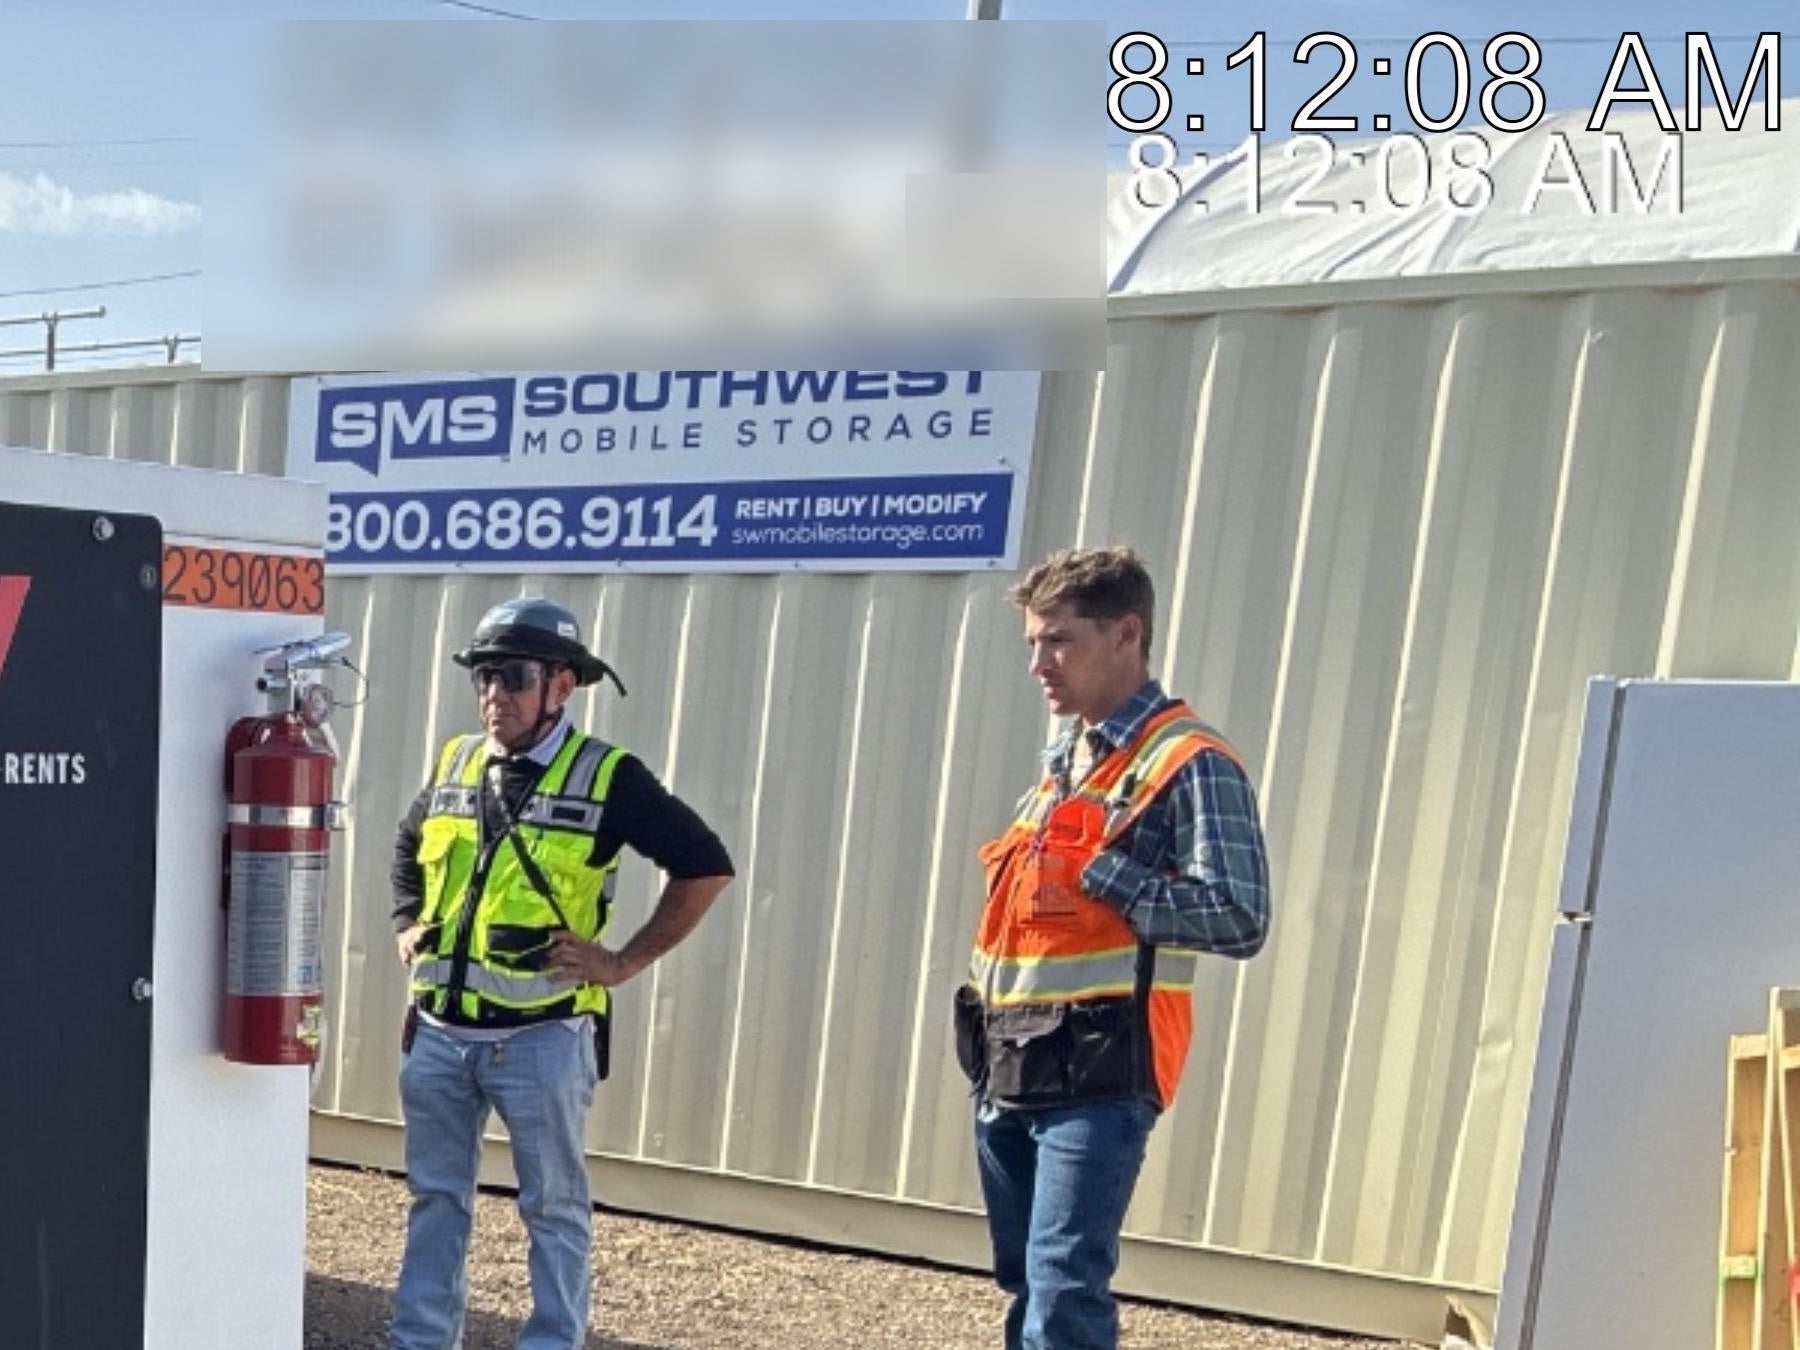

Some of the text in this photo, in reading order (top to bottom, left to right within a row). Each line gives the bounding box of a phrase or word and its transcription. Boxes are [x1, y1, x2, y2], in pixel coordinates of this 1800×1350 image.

[330, 394, 498, 449] SMS
[522, 408, 993, 456] MOBILE STORAGE
[326, 493, 718, 552] 800.686.9114
[734, 491, 988, 520] RENT BUY MODIFY
[731, 522, 984, 550] swmobilestorage.com
[162, 546, 325, 611] 239063
